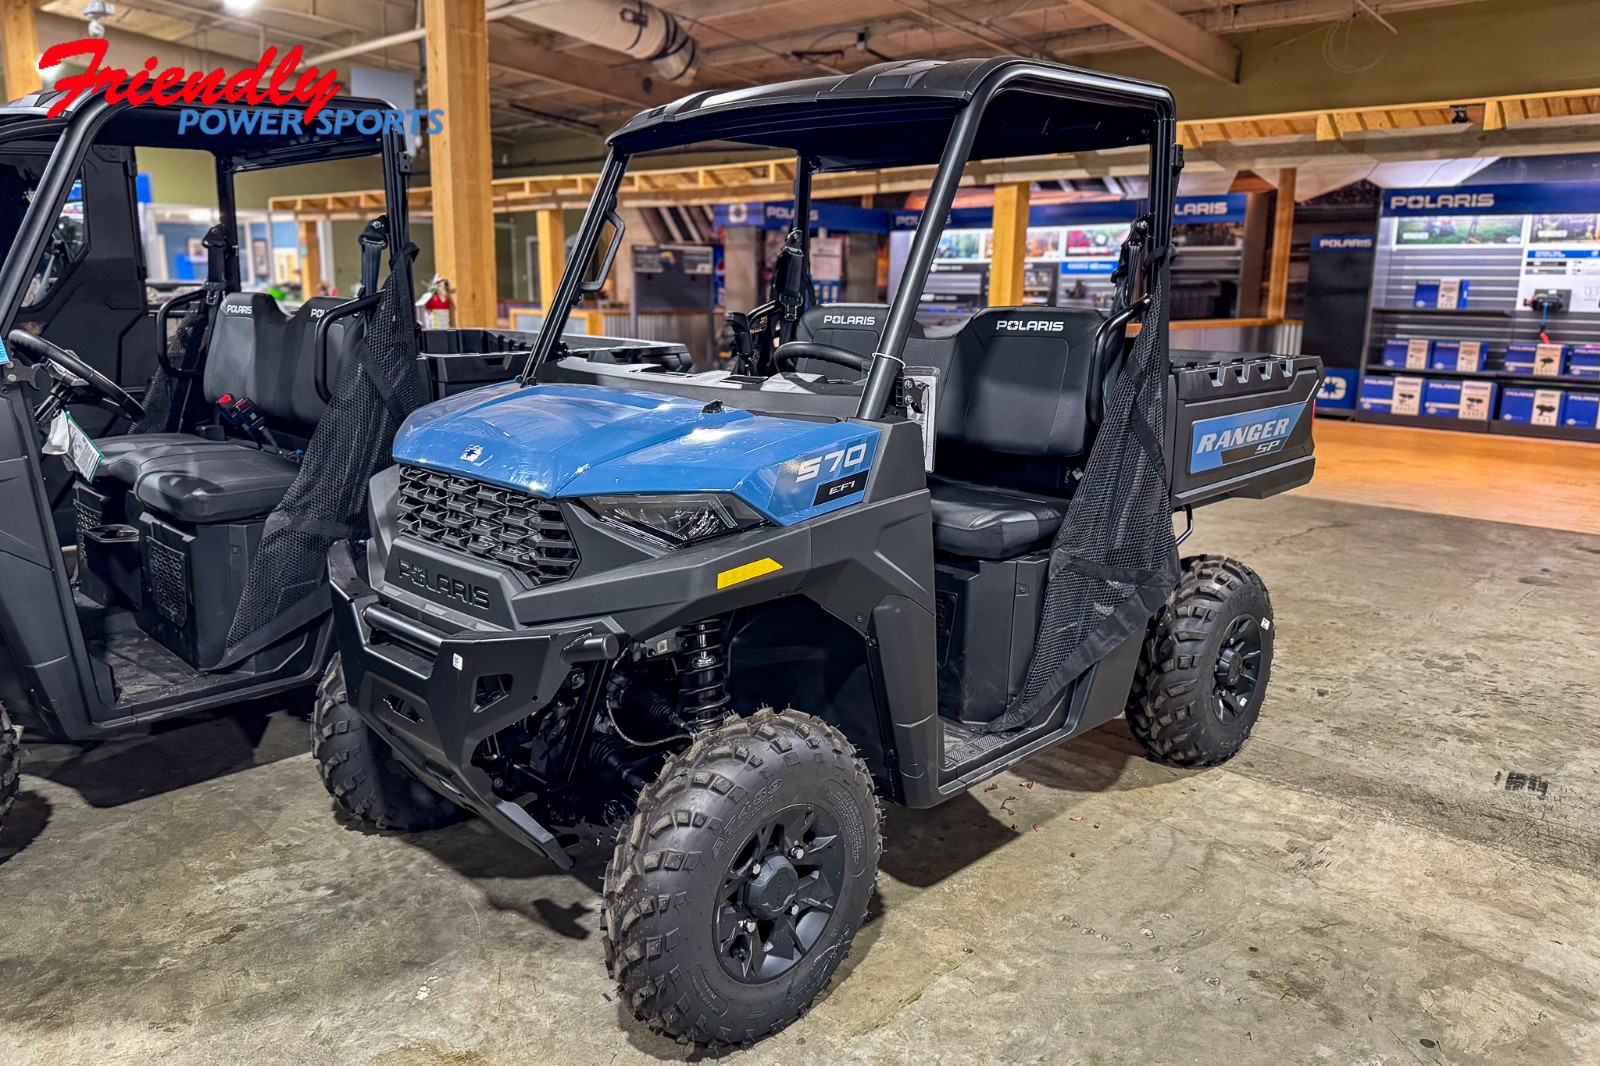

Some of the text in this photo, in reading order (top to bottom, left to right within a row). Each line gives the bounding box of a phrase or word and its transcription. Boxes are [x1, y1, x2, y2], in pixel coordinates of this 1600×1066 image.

[1174, 201, 1228, 216] LARIS
[1390, 193, 1495, 210] POLARIS
[1319, 238, 1372, 249] POLARIS
[226, 304, 253, 315] POLARIS
[823, 314, 876, 326] POLARIS
[995, 319, 1064, 332] POLARIS
[1195, 417, 1290, 455] RANGER
[1254, 439, 1281, 455] SP
[795, 442, 868, 484] 570
[828, 480, 856, 496] EFI
[398, 559, 491, 611] POLARIS
